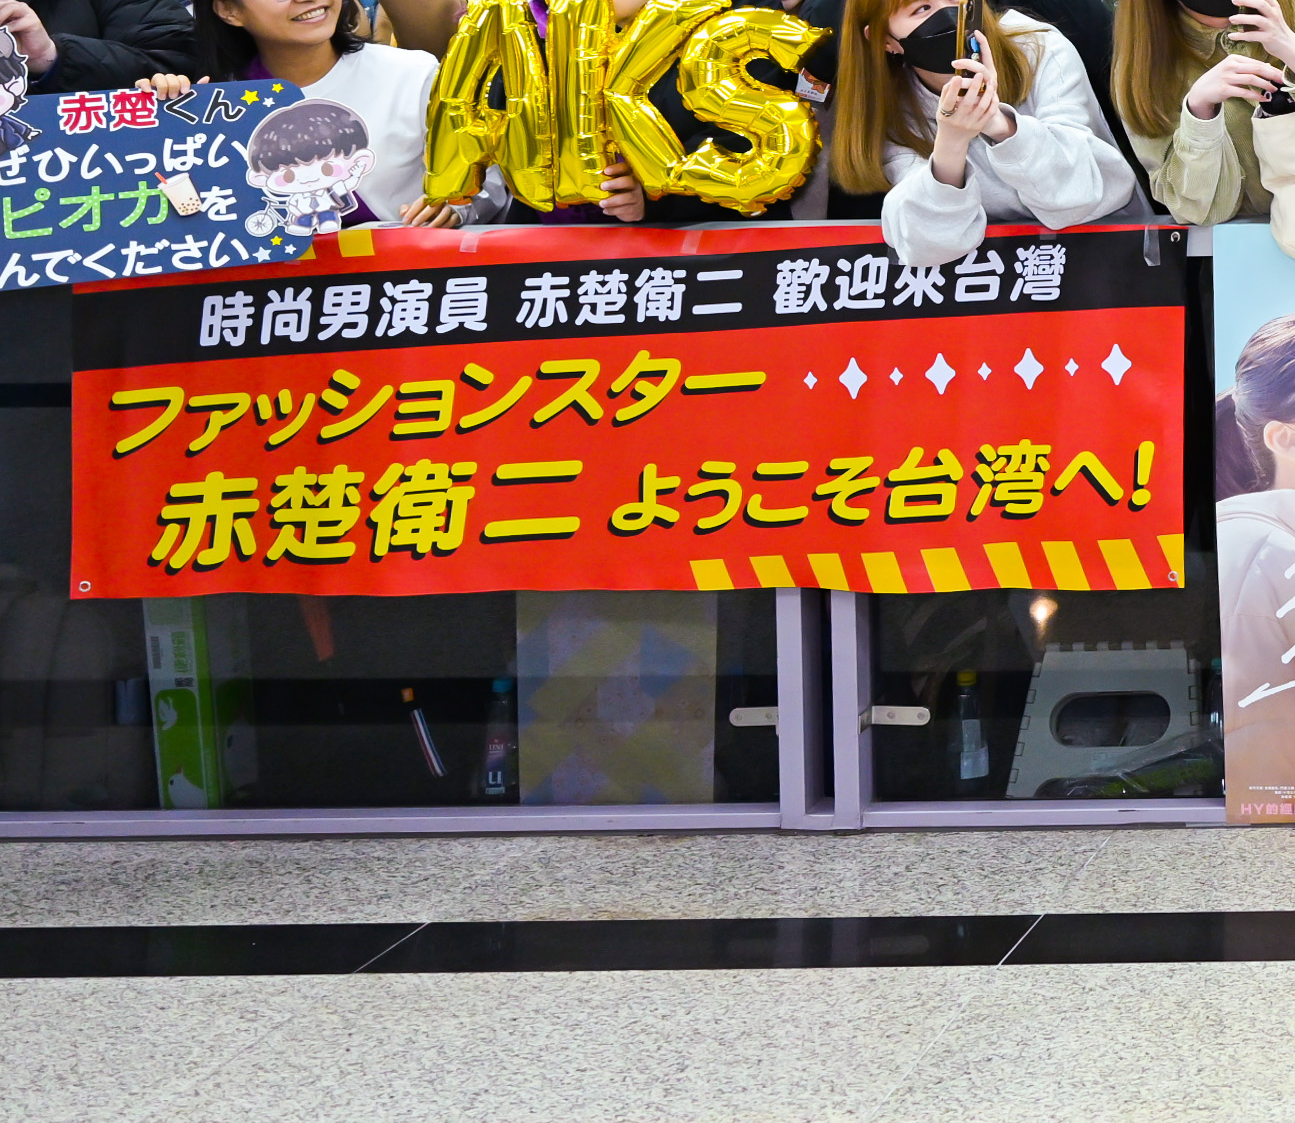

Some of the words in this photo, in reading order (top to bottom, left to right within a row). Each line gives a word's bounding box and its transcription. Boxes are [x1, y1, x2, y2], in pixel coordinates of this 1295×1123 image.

[59, 88, 246, 134] 赤楚くん
[200, 277, 489, 346] 時尚男演員
[515, 266, 744, 330] 赤楚衛二
[772, 243, 1067, 315] 歡迎來台灣
[112, 349, 767, 454] ファッションスター
[149, 458, 584, 569] 赤楚衛二
